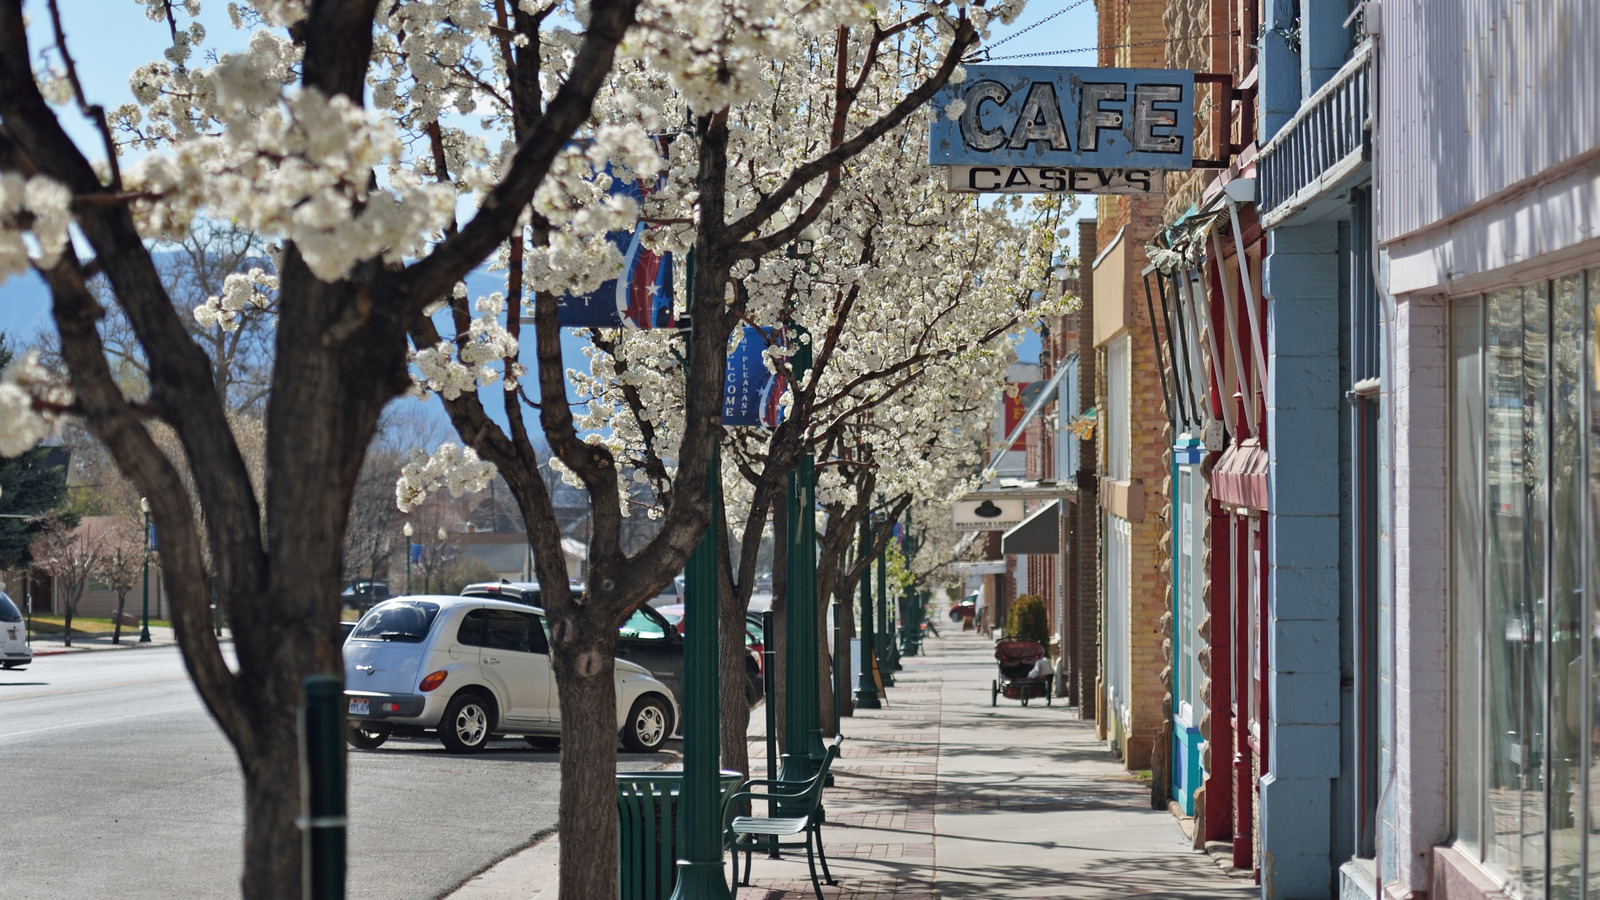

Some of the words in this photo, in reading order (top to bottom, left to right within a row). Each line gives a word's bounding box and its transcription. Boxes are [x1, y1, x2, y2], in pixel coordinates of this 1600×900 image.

[959, 79, 1183, 154] CAFE
[969, 167, 1151, 192] CASEY'S
[740, 338, 747, 352] MT
[741, 356, 749, 416] PLEASANT
